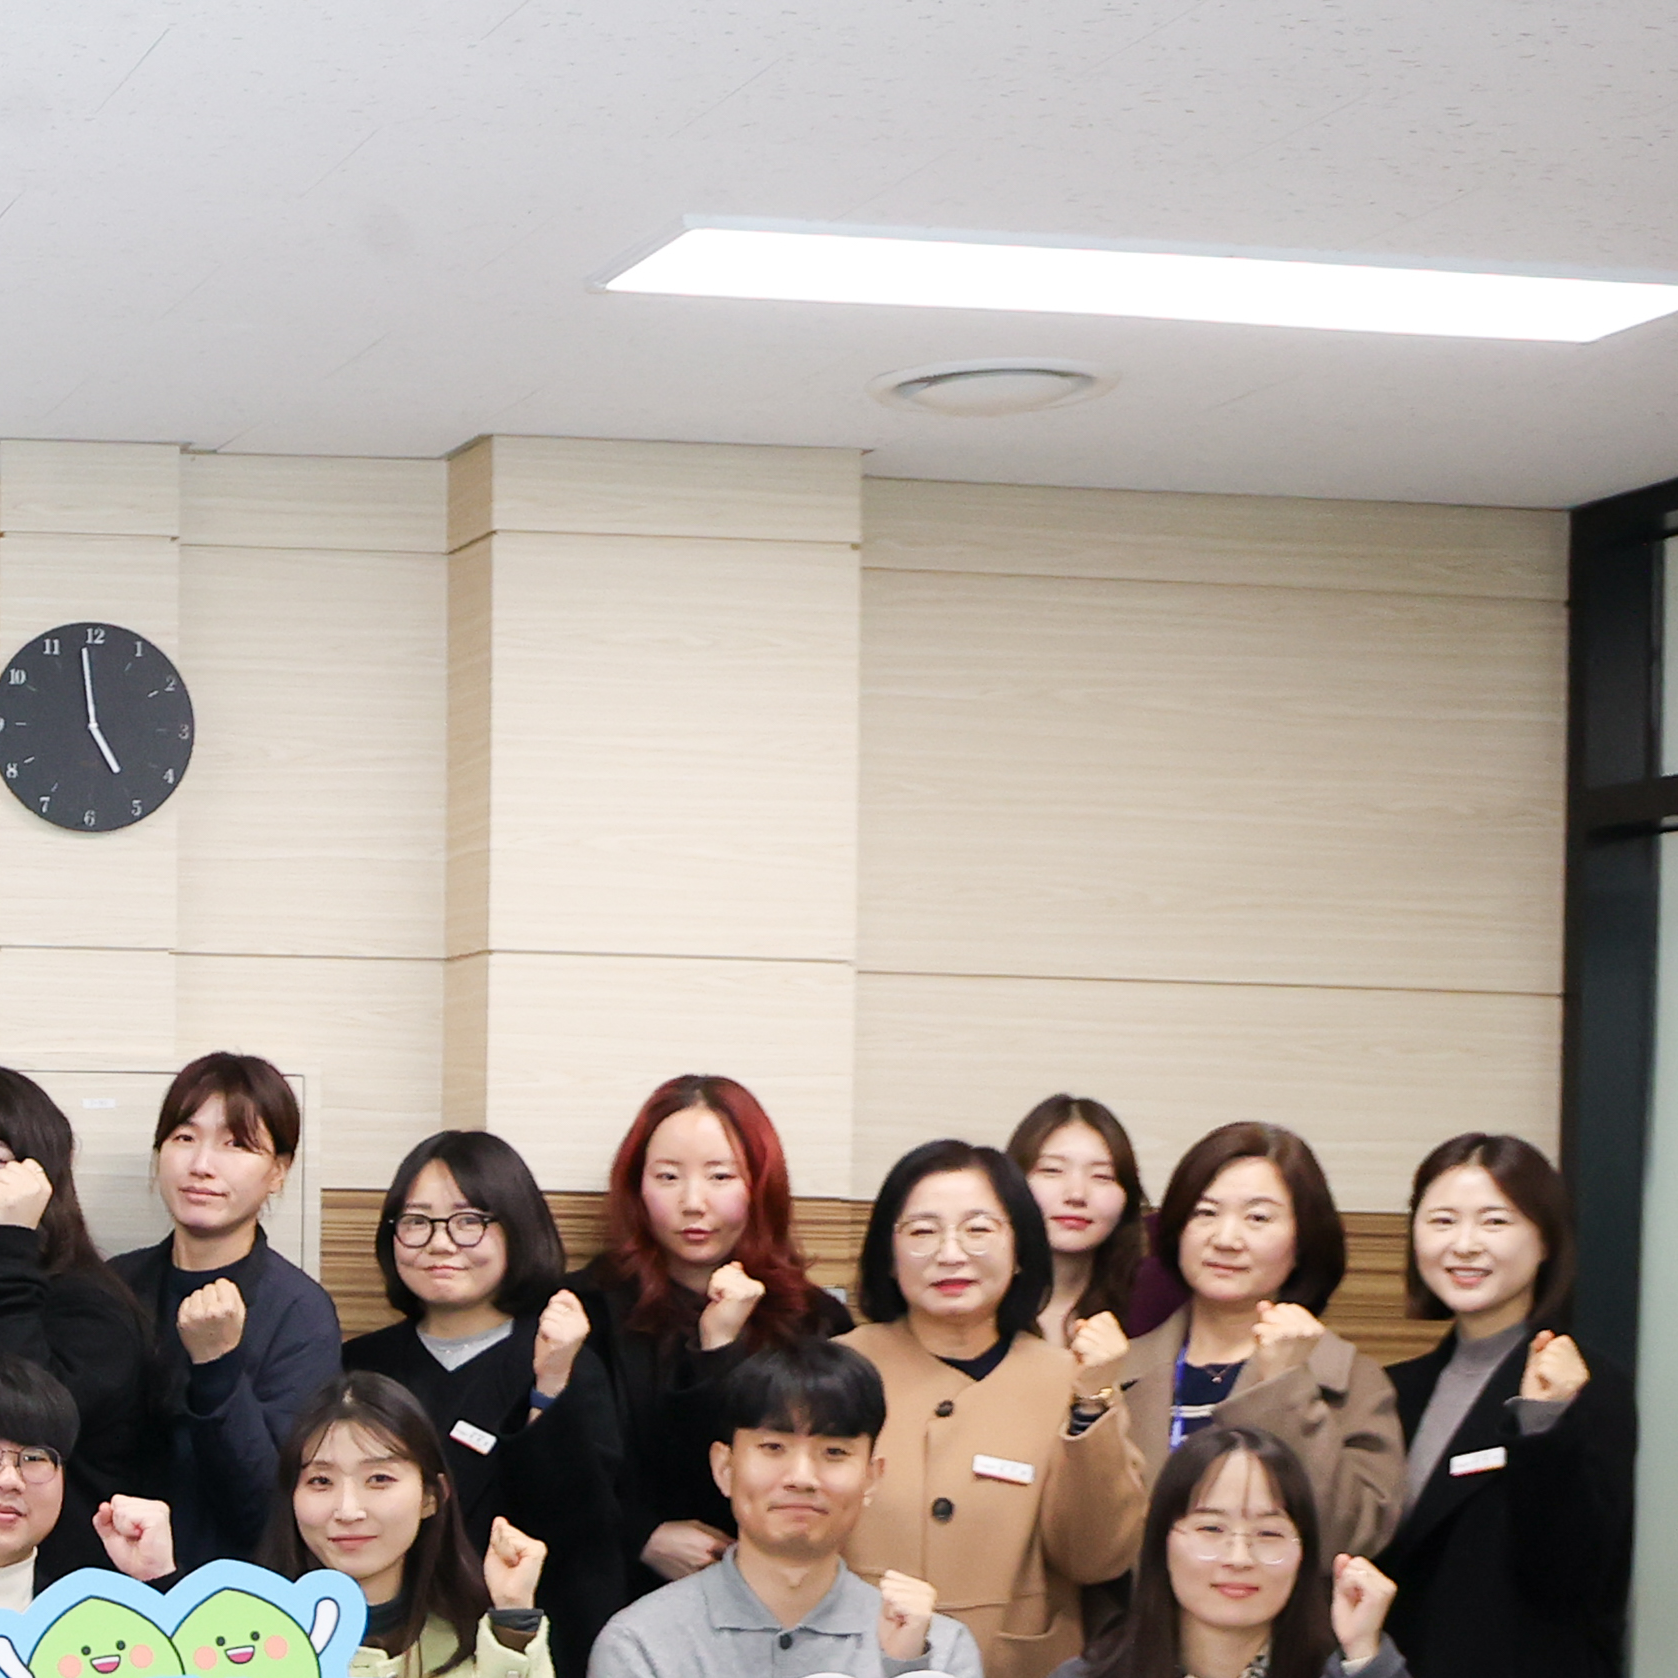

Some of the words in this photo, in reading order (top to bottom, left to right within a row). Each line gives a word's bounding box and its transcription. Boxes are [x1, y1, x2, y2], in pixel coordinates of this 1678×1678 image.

[85, 627, 105, 644] 12
[43, 638, 60, 655] 11
[134, 641, 144, 657] 1
[9, 668, 27, 685] 10
[164, 675, 177, 691] 2
[178, 724, 190, 740] 3
[6, 763, 19, 779] 8
[163, 768, 175, 784] 4
[39, 796, 51, 812] 7
[132, 800, 143, 816] 5
[83, 810, 96, 827] 6
